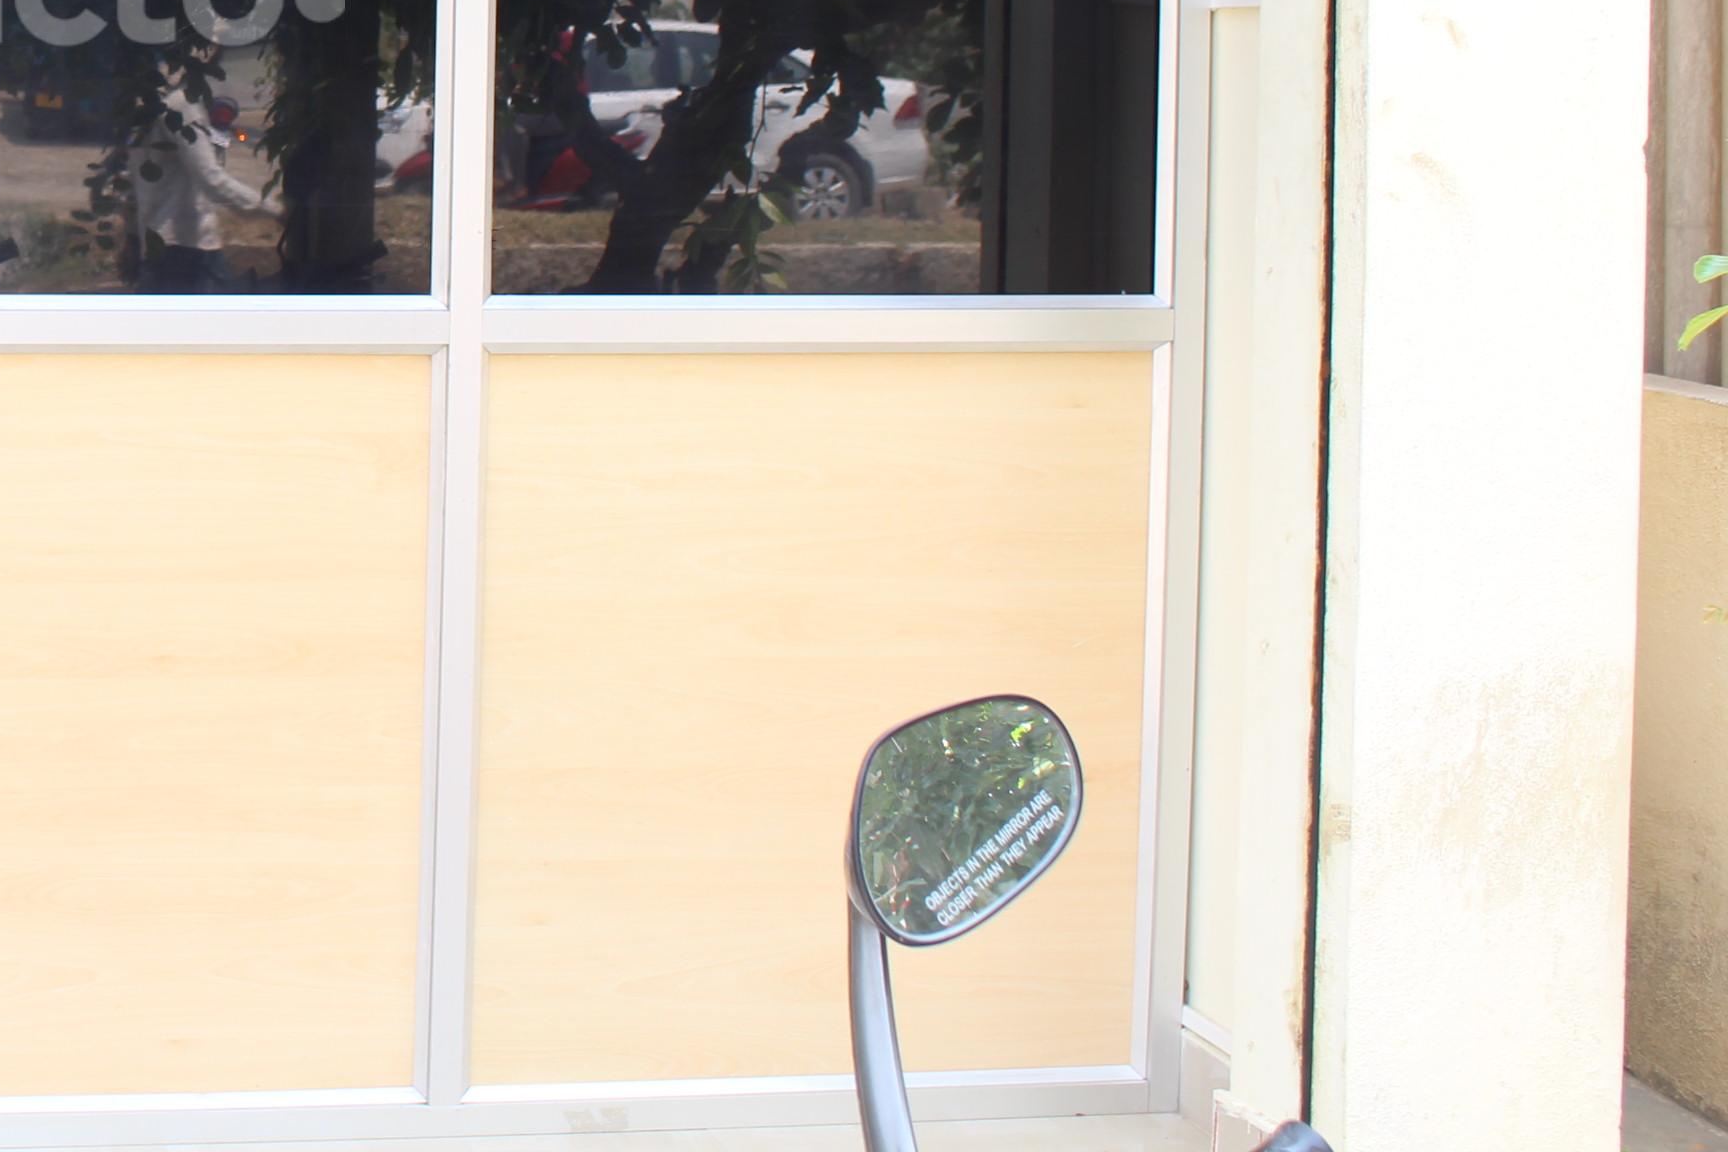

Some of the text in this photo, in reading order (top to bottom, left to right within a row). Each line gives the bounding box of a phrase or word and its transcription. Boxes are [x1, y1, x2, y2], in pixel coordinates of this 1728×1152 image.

[925, 789, 1052, 910] OBJECTS IN THE MIRROR ARE
[937, 805, 1064, 926] CLOSER THAN THEY APPEAR
